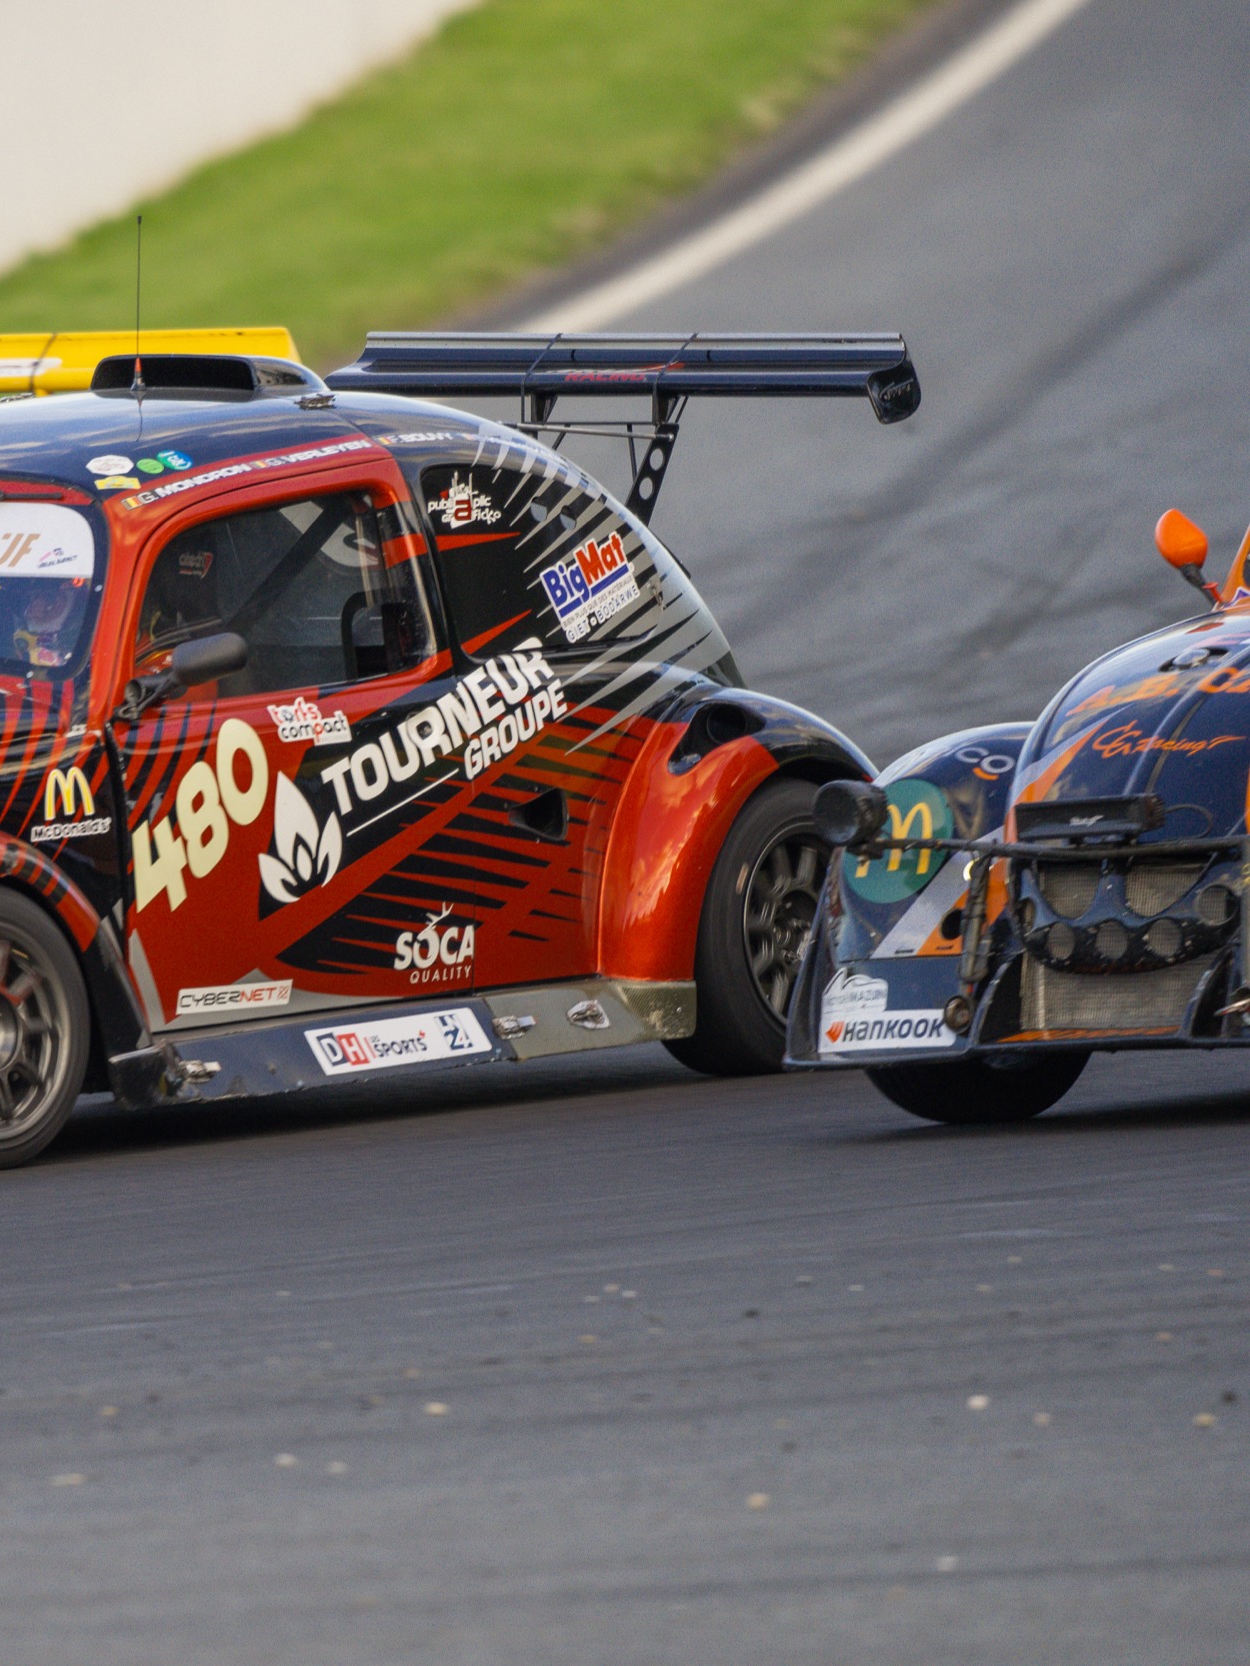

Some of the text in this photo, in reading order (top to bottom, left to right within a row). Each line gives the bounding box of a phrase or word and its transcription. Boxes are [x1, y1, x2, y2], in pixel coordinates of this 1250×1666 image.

[542, 532, 627, 609] BigMat
[281, 712, 348, 743] compact
[320, 637, 554, 816] TOURNEUR
[464, 678, 568, 780] GROUPE
[132, 718, 269, 913] 480
[393, 923, 475, 971] SOCA
[410, 965, 471, 984] QUALITY
